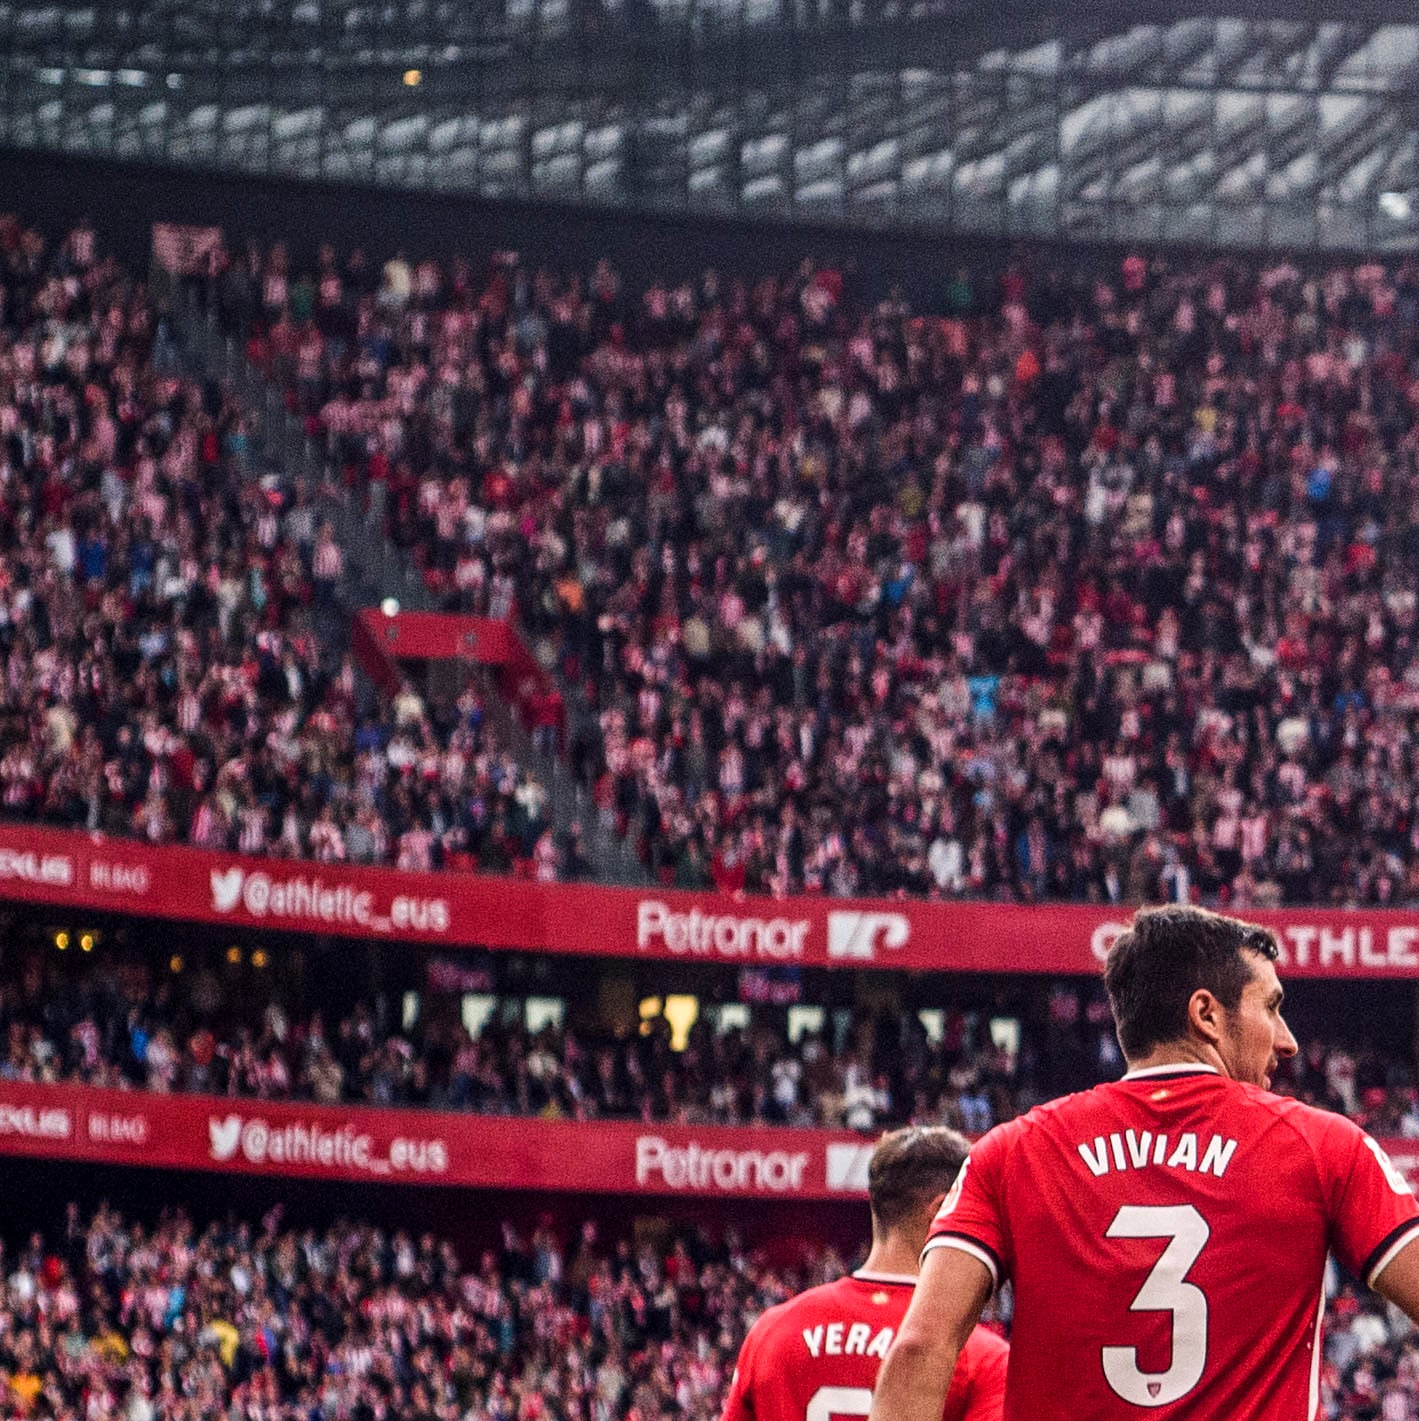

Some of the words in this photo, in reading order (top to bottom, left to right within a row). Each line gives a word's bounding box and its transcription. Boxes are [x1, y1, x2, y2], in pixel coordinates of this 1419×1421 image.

[242, 871, 449, 933] @athletic_eus
[637, 899, 812, 957] Petronor
[242, 1115, 449, 1173] @athletic_eus
[635, 1135, 808, 1191] Petronor
[1077, 1128, 1238, 1178] VIVIAN
[1102, 1204, 1211, 1407] 3
